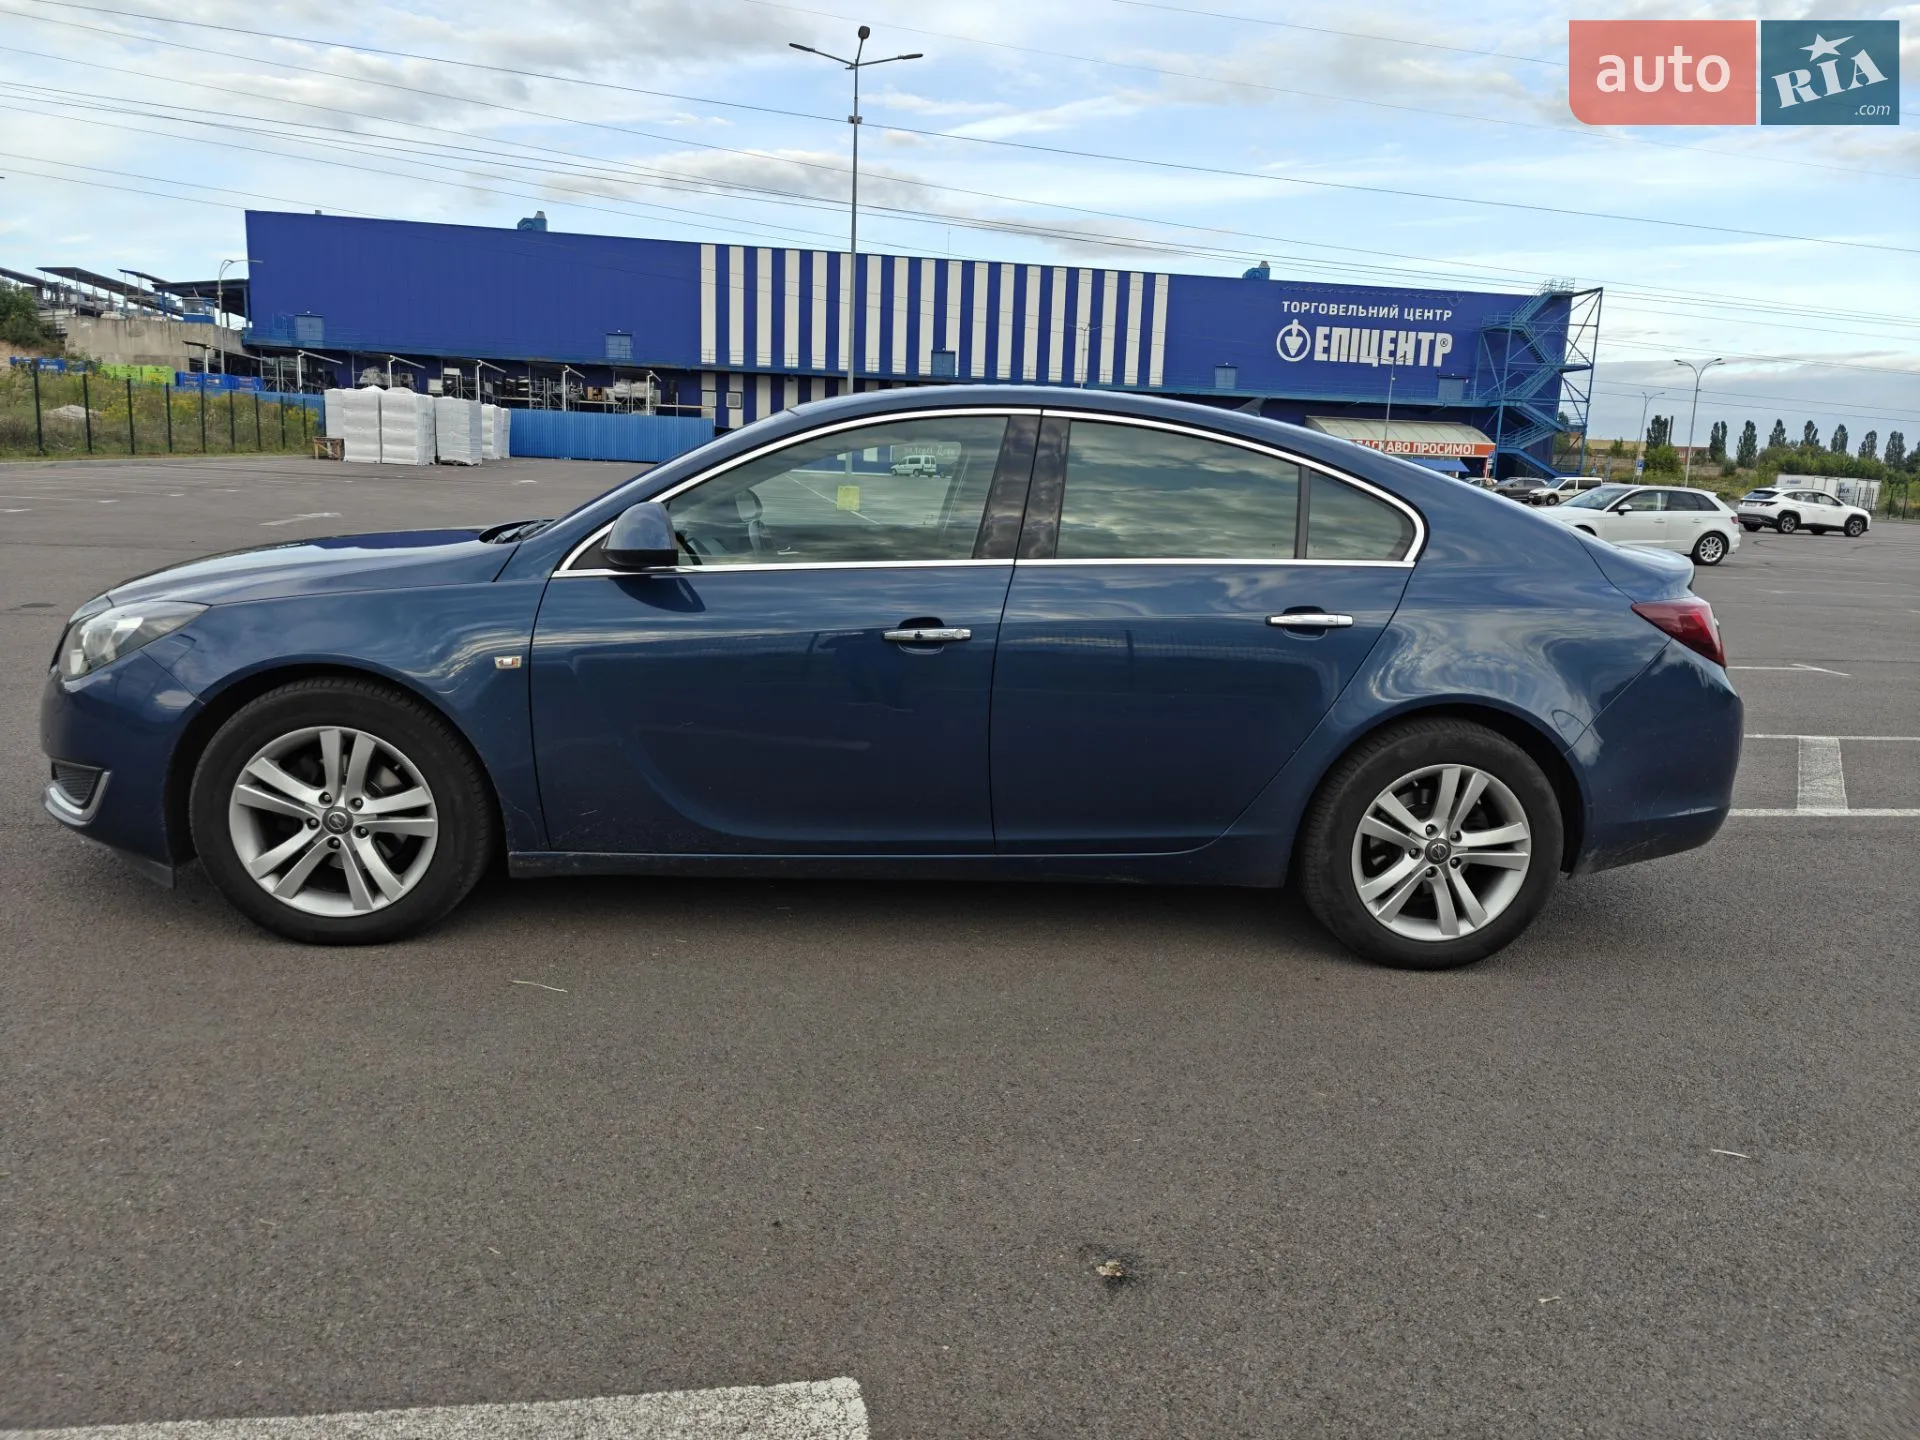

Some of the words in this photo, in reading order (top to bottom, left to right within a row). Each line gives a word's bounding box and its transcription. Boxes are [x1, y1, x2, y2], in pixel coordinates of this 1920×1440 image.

[1282, 301, 1399, 318] ТОРГОВЕЛЬНИЙ
[1403, 308, 1453, 321] ЦЕНТР
[1313, 326, 1453, 367] ЕПІЦЕНТР
[1413, 442, 1475, 455] ПРОСИМО!
